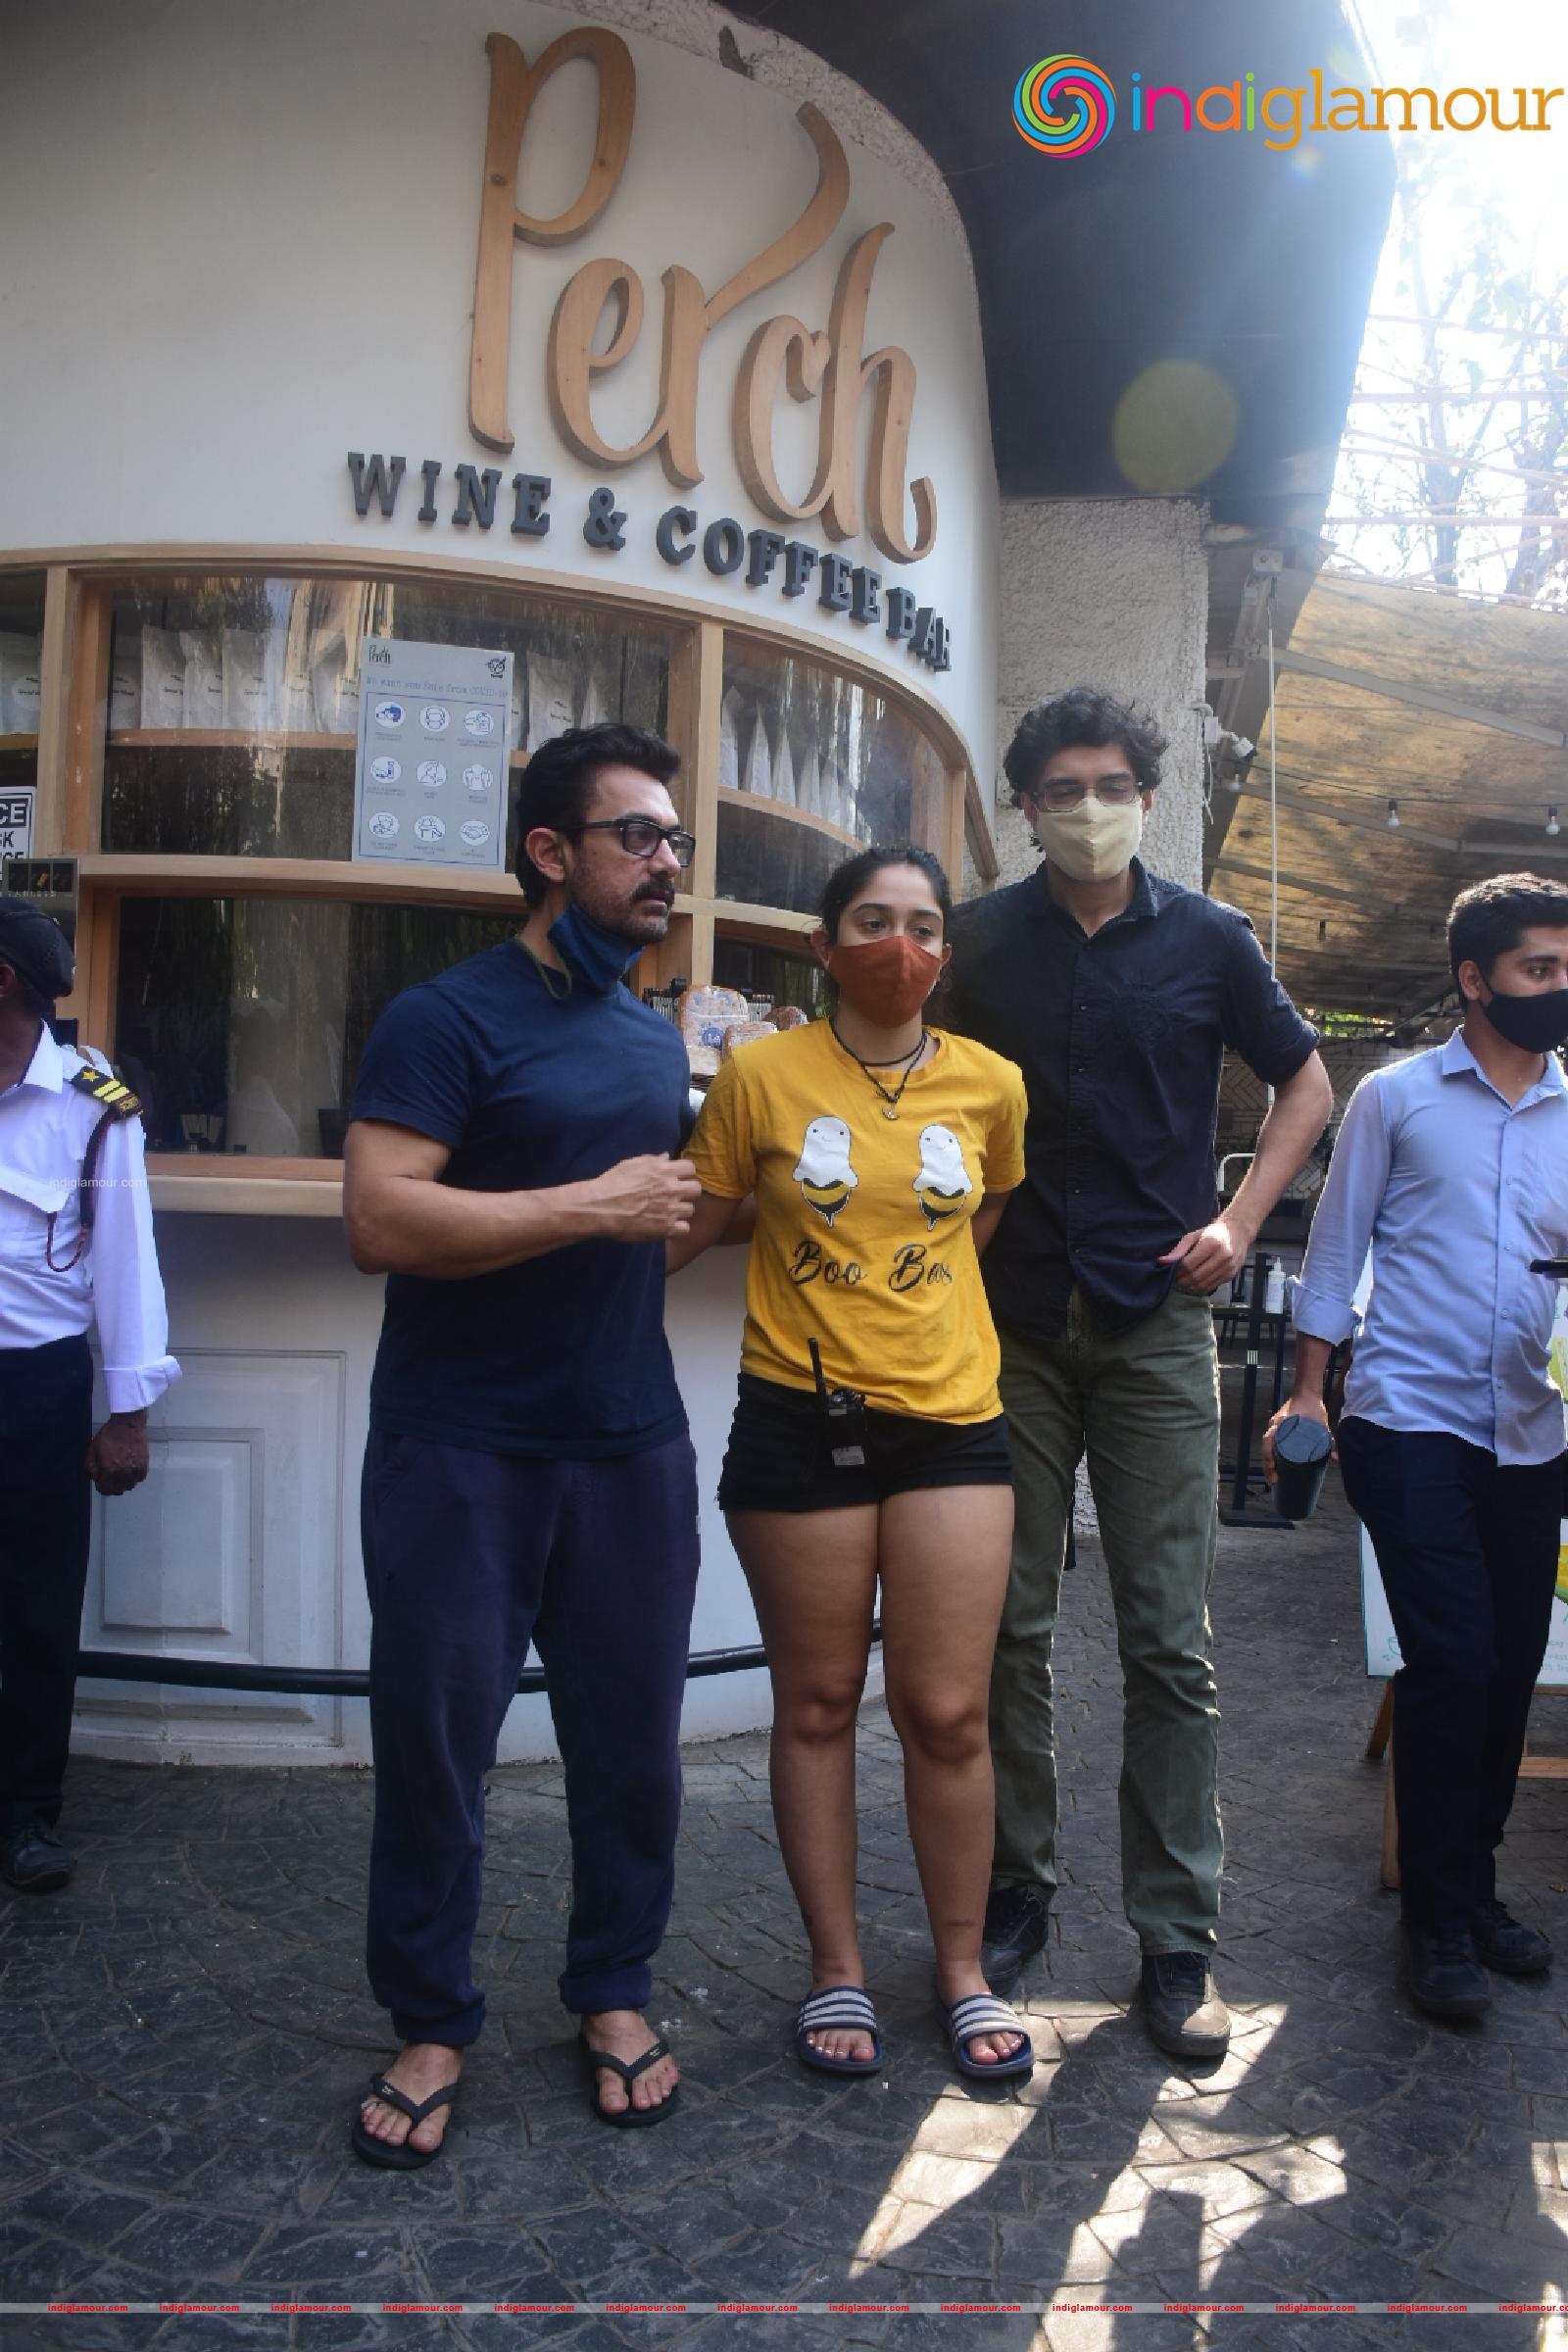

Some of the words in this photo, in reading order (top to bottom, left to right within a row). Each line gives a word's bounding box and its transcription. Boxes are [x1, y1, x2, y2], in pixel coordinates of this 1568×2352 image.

[467, 25, 937, 564] Perch
[347, 451, 552, 537] WINE
[583, 487, 626, 553] &
[656, 506, 883, 624] COFFEE
[885, 586, 953, 672] BAR
[0, 830, 15, 849] K
[788, 1240, 867, 1287] Boo
